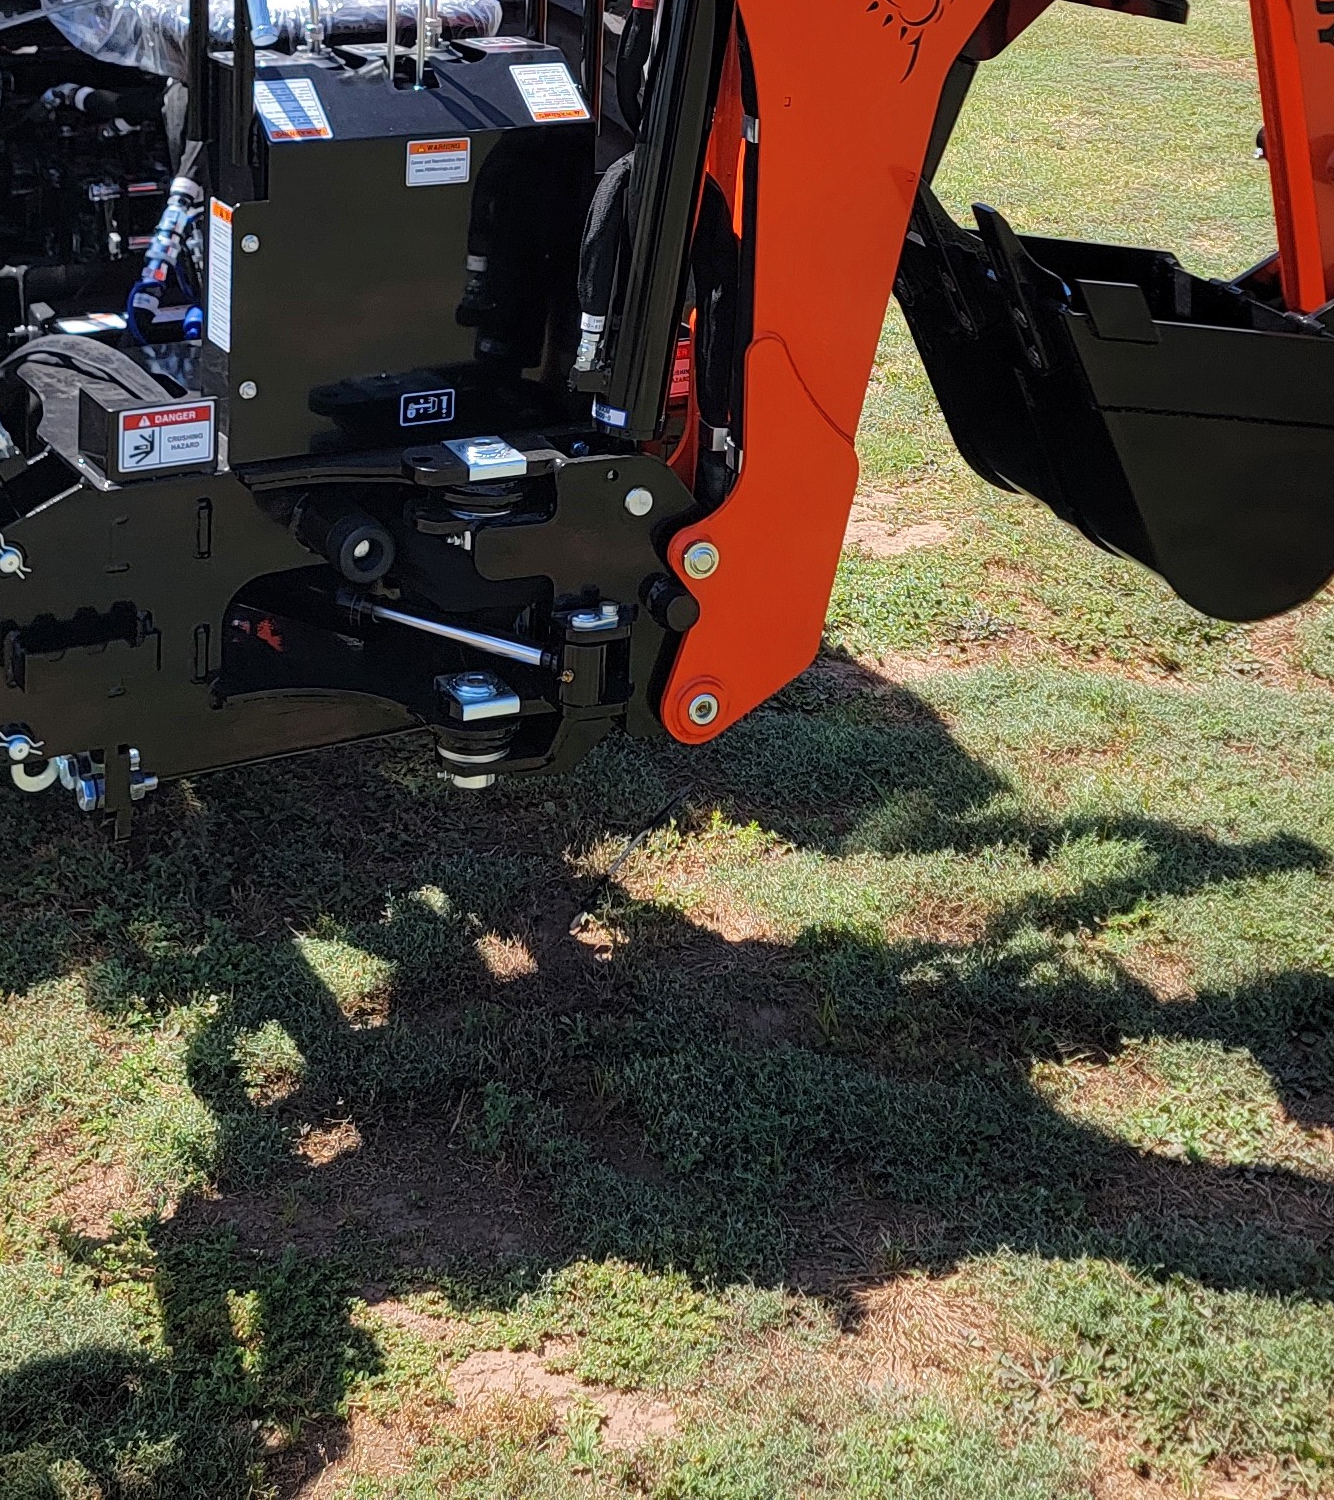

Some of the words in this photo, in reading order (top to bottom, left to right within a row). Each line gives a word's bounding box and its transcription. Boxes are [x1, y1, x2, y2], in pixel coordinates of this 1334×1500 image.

[155, 411, 196, 424] DANGER
[167, 432, 203, 443] CRUSHING
[170, 441, 201, 451] HAZARD
